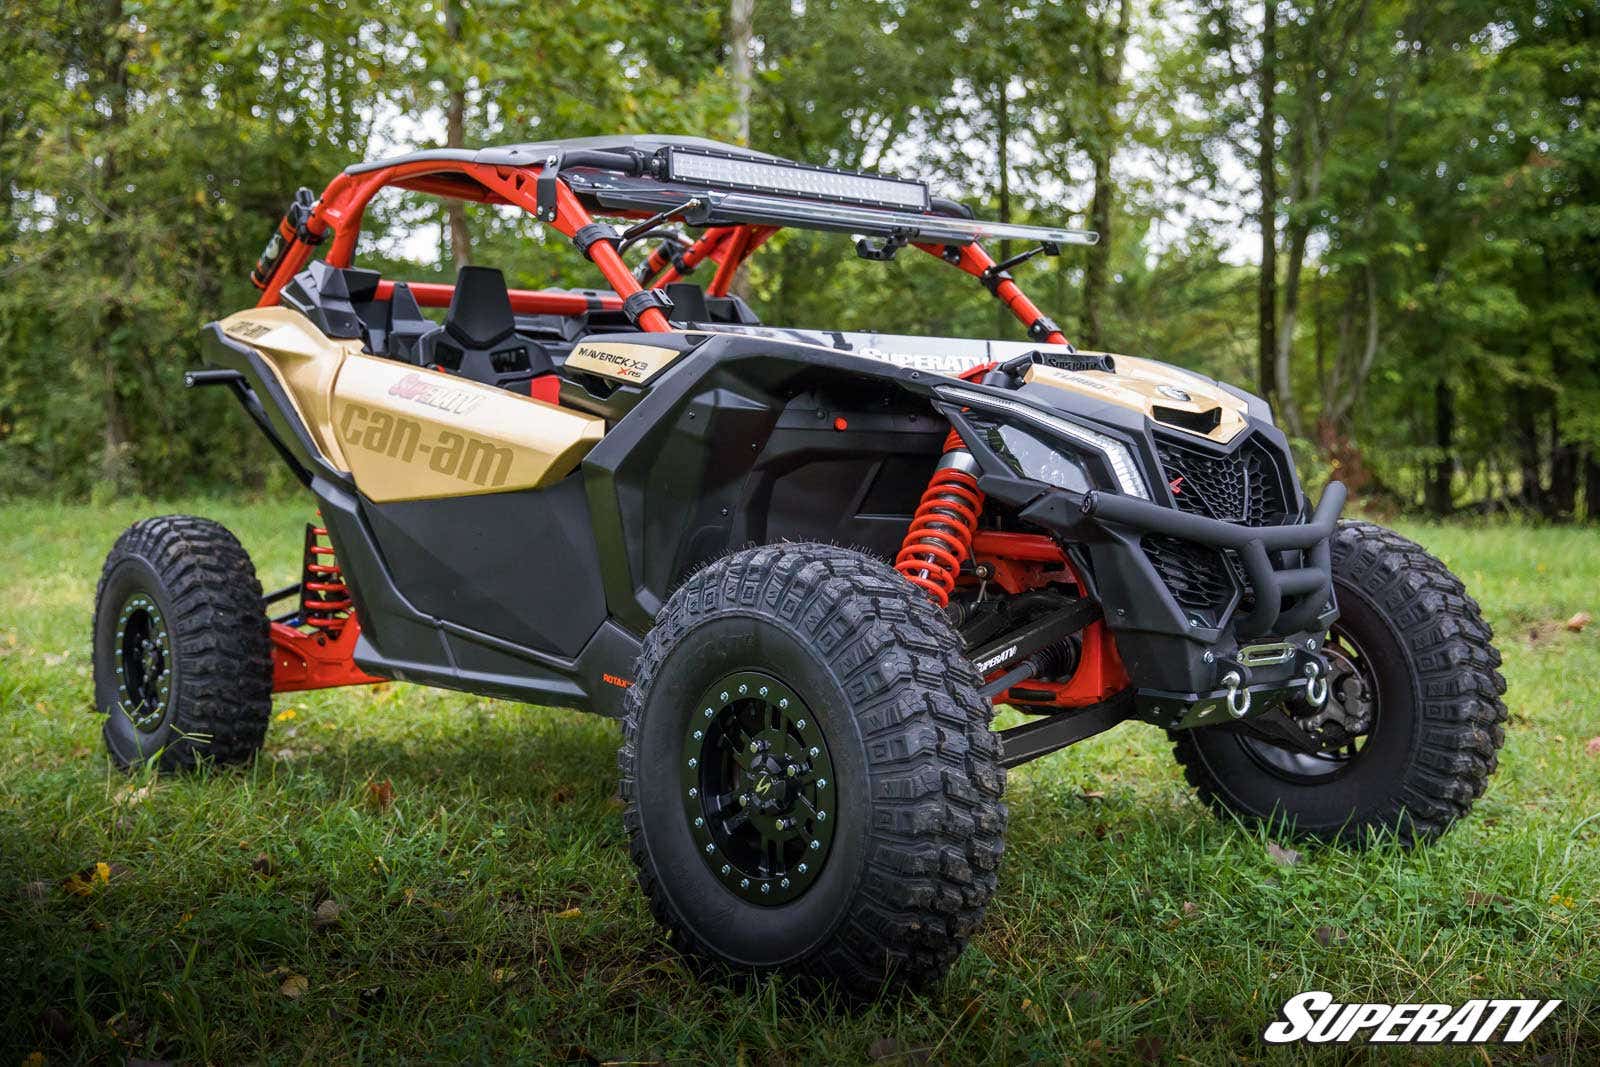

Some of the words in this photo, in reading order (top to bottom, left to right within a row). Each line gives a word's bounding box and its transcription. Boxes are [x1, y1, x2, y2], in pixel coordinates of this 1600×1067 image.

[578, 347, 631, 367] MAVERICK
[629, 359, 649, 371] X3
[340, 403, 514, 487] can-am
